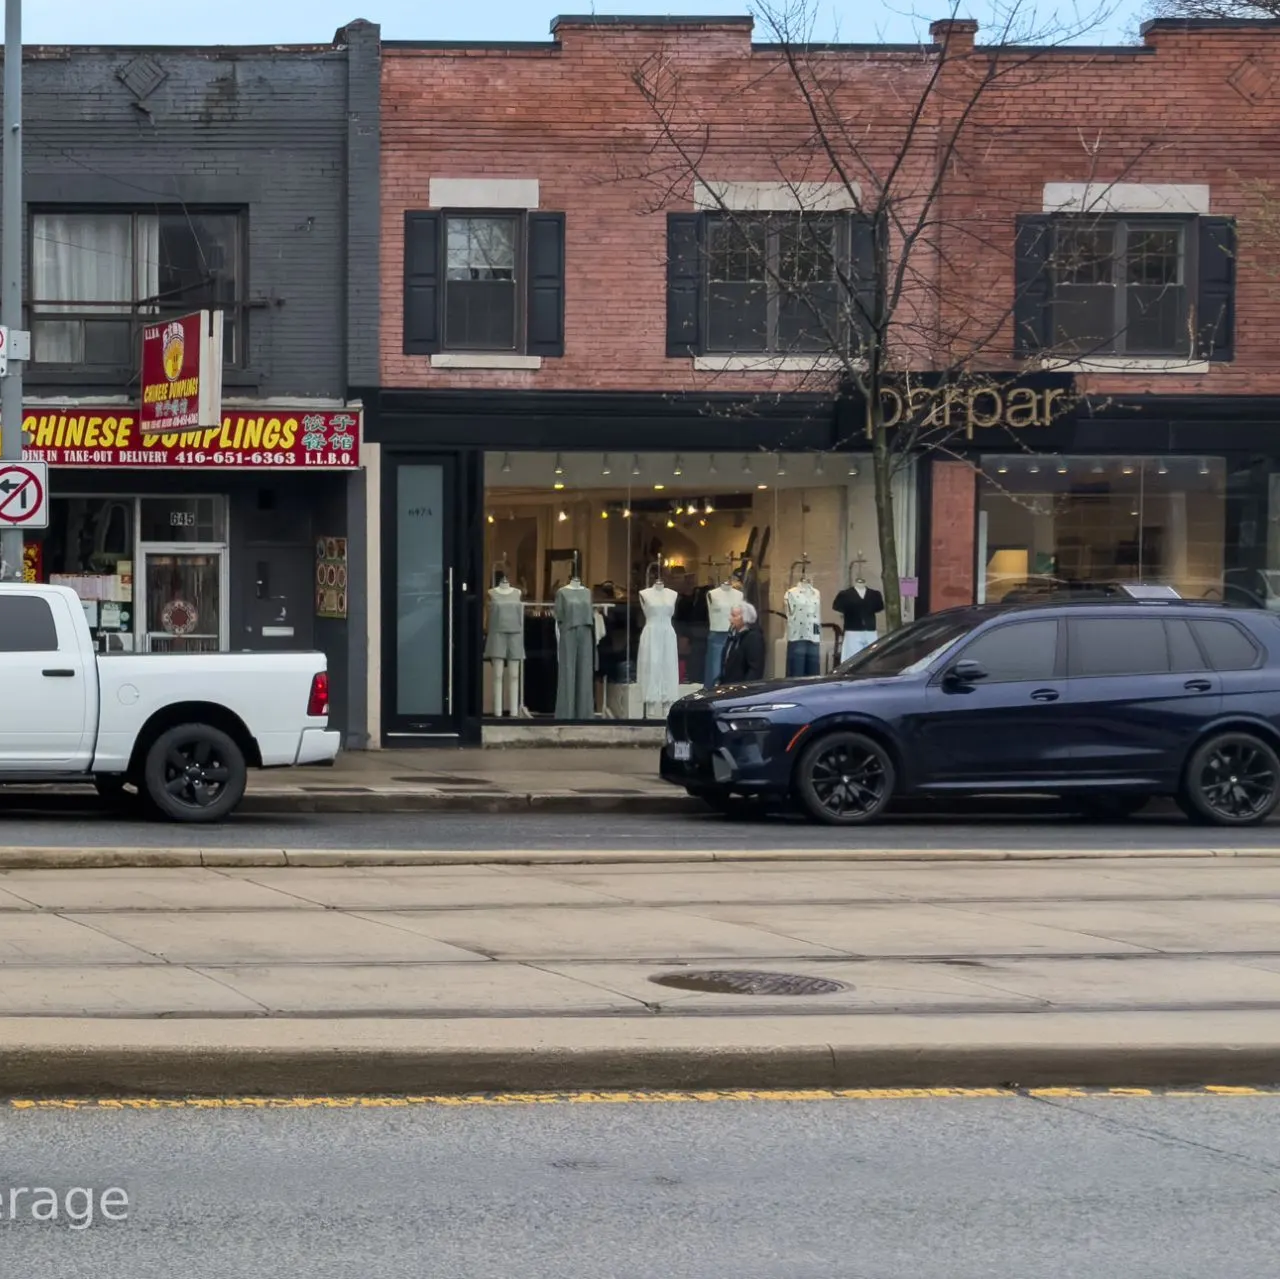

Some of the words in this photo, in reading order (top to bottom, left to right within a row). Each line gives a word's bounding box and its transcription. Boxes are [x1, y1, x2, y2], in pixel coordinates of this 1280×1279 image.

[866, 386, 1065, 440] parpar
[22, 415, 134, 447] CHINESE
[22, 450, 44, 462] DINE
[46, 450, 58, 462] IN
[64, 450, 113, 462] TAKE-OUT
[119, 450, 168, 463] DELIVERY
[175, 451, 296, 464] 416-651-6363
